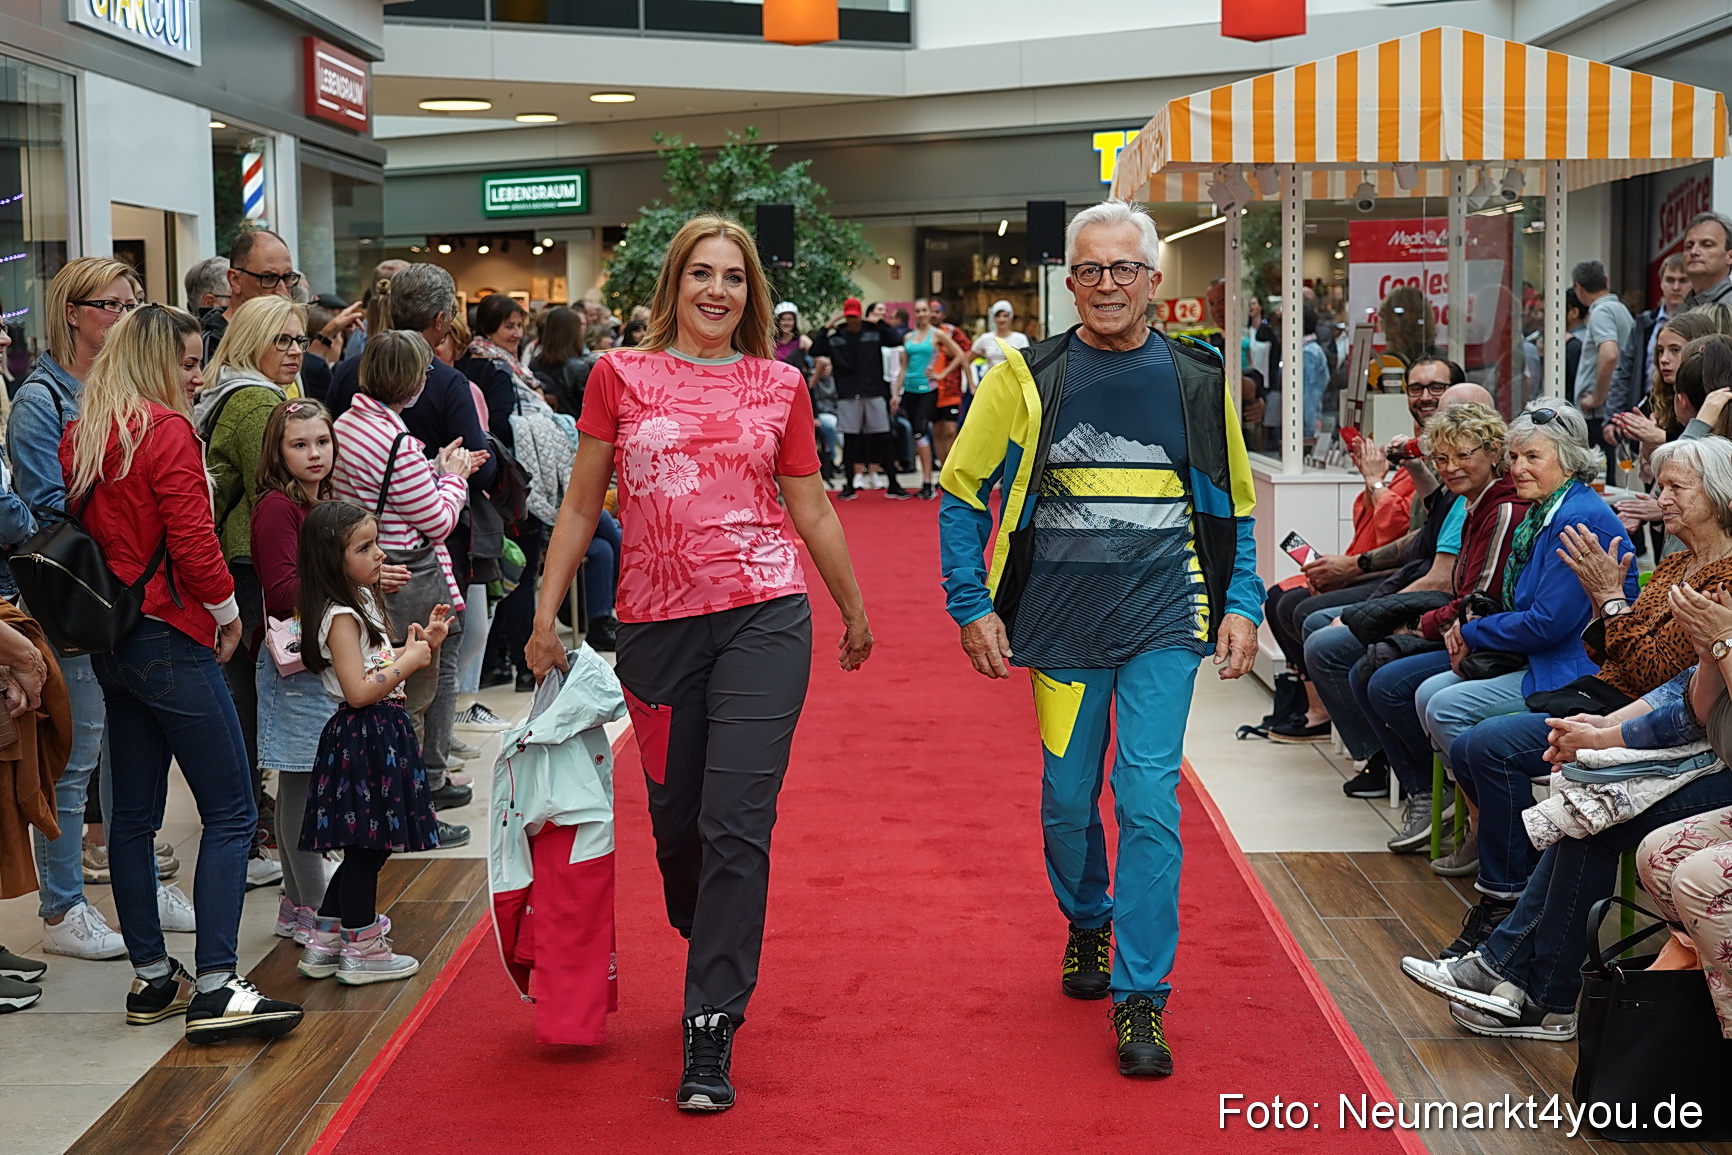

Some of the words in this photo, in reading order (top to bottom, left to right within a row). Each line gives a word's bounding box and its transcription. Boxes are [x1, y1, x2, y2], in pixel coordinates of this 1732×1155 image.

[320, 66, 364, 106] LEBENSRAUM
[1093, 130, 1141, 184] T
[491, 183, 576, 203] LEBENSRAUM
[70, 928, 85, 941] FILA
